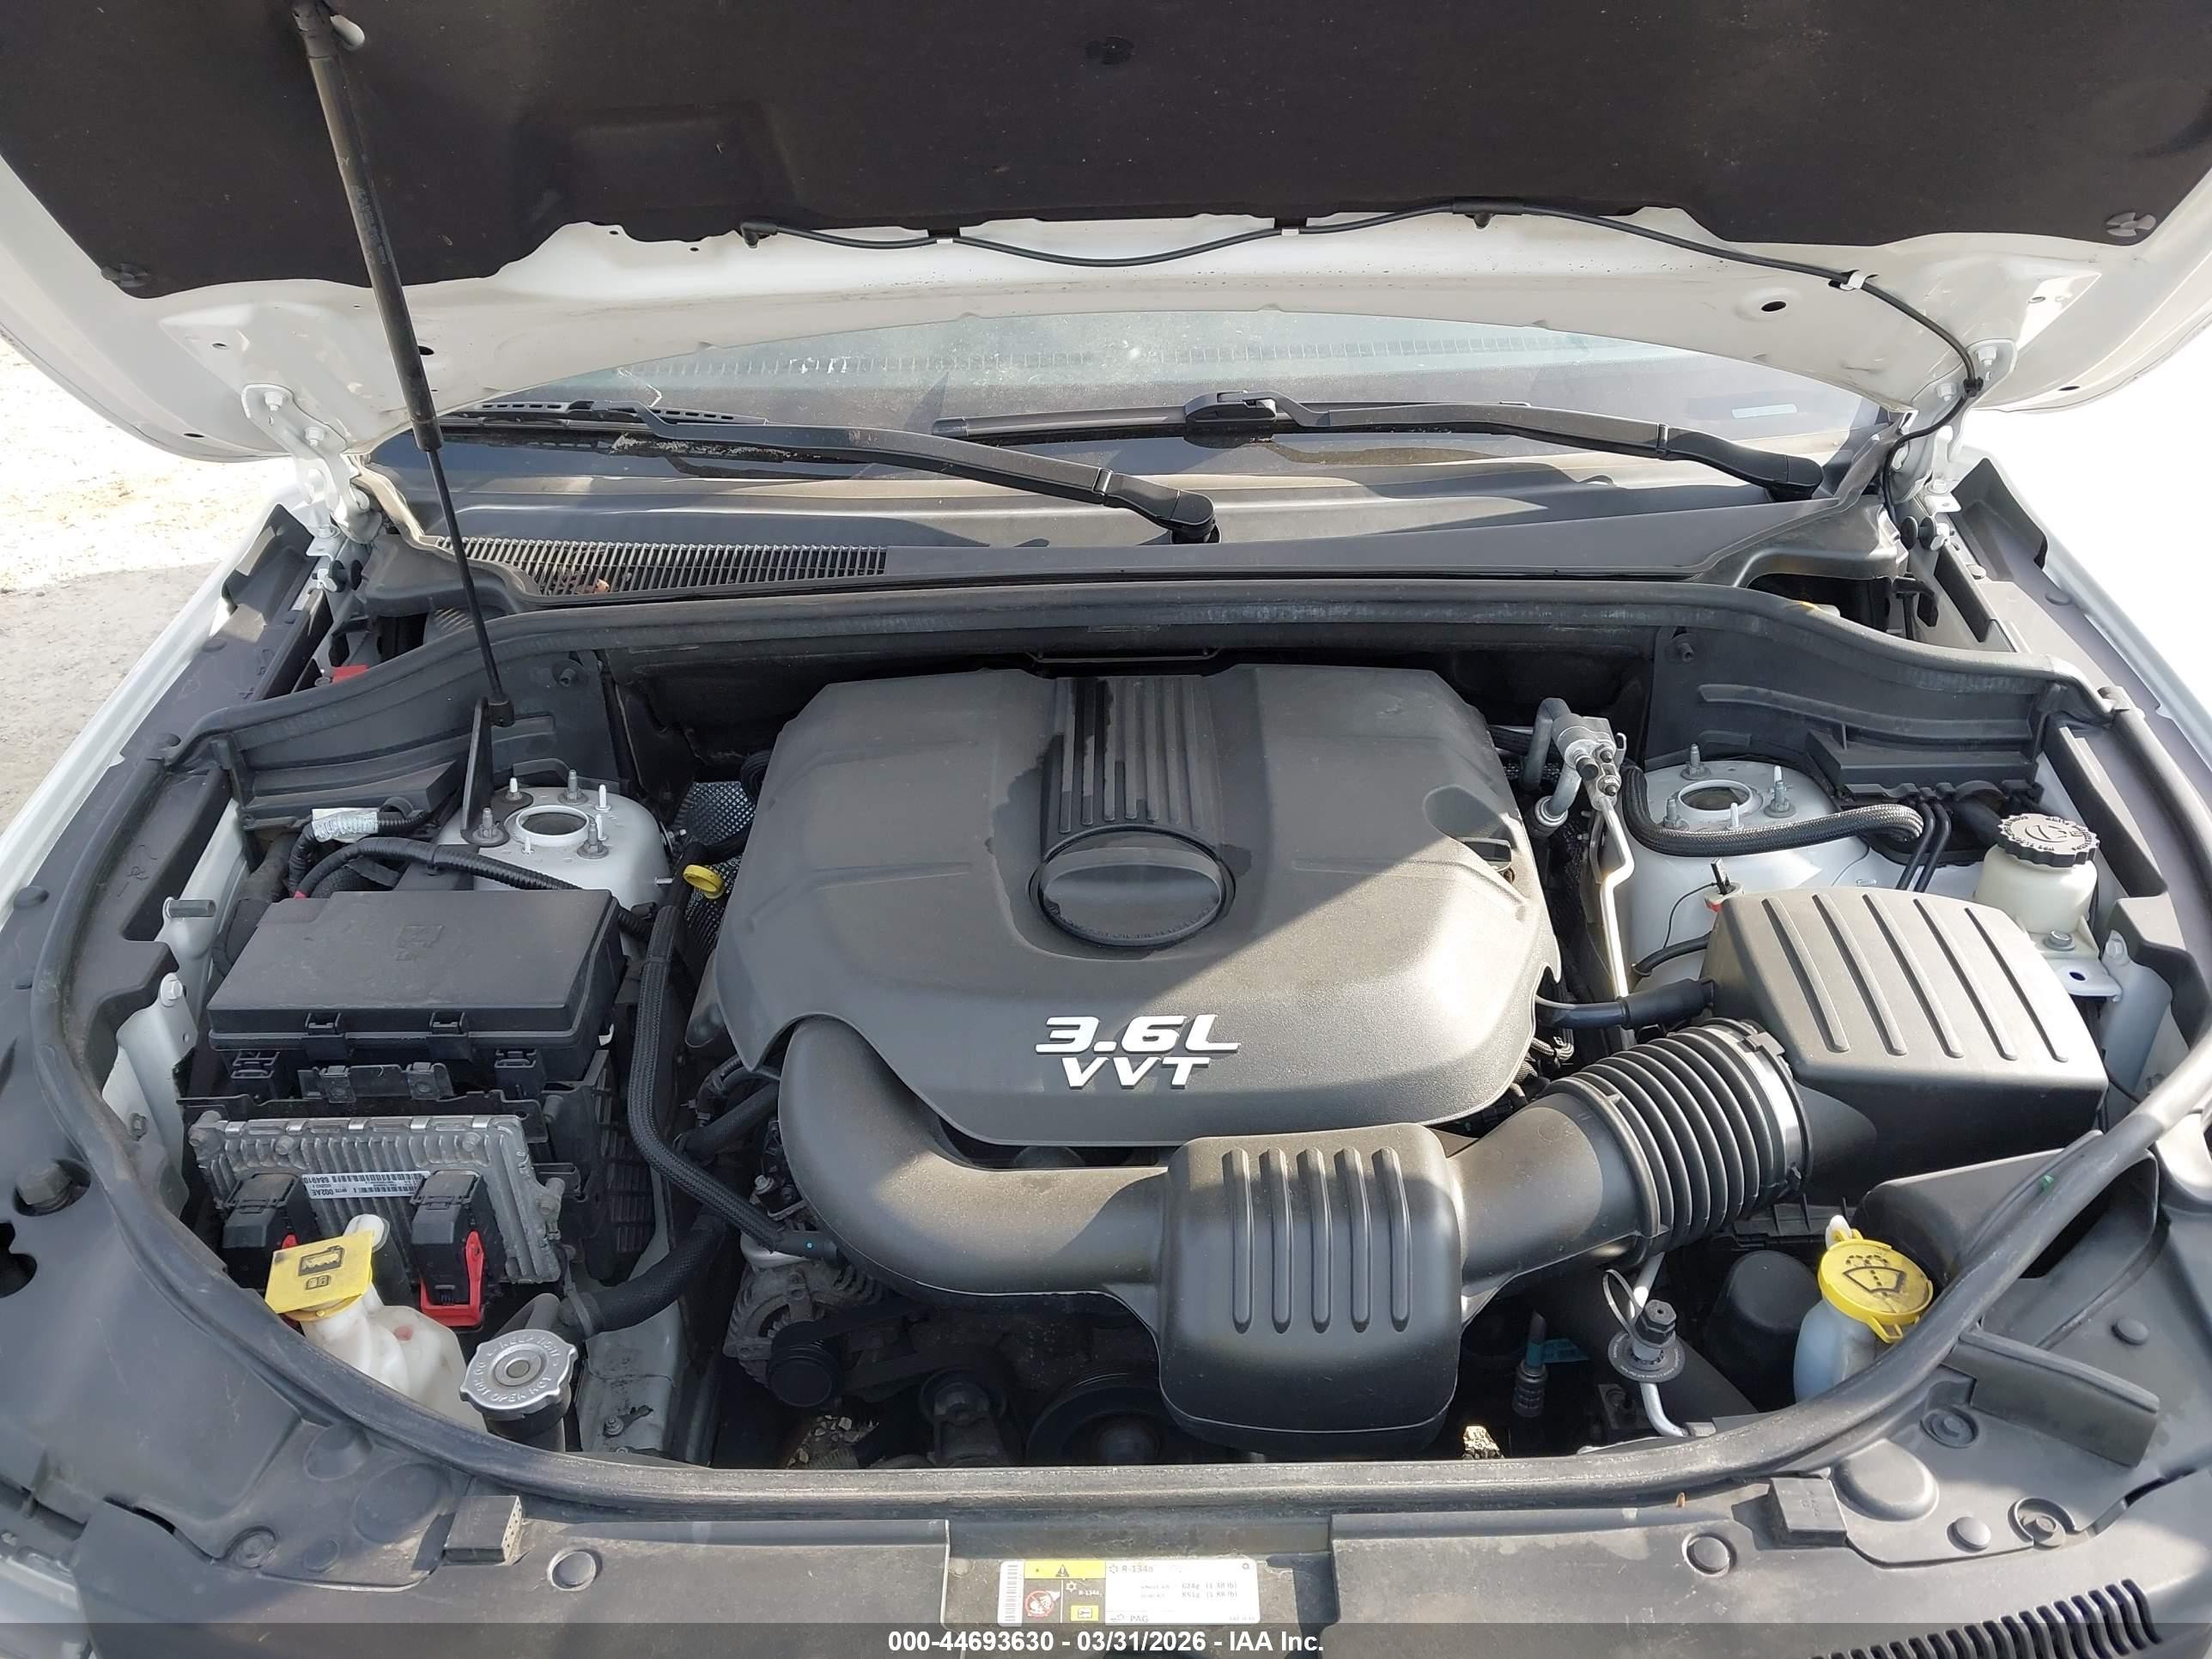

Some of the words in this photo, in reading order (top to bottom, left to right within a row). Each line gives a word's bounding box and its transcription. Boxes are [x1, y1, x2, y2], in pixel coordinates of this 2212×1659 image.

[1034, 1013, 1241, 1054] 3.6L
[1061, 1056, 1211, 1090] VVT
[498, 1334, 535, 1349] KEEP
[490, 1391, 527, 1402] OPEN
[527, 1376, 552, 1395] HOT
[1130, 1614, 1149, 1623] PAG
